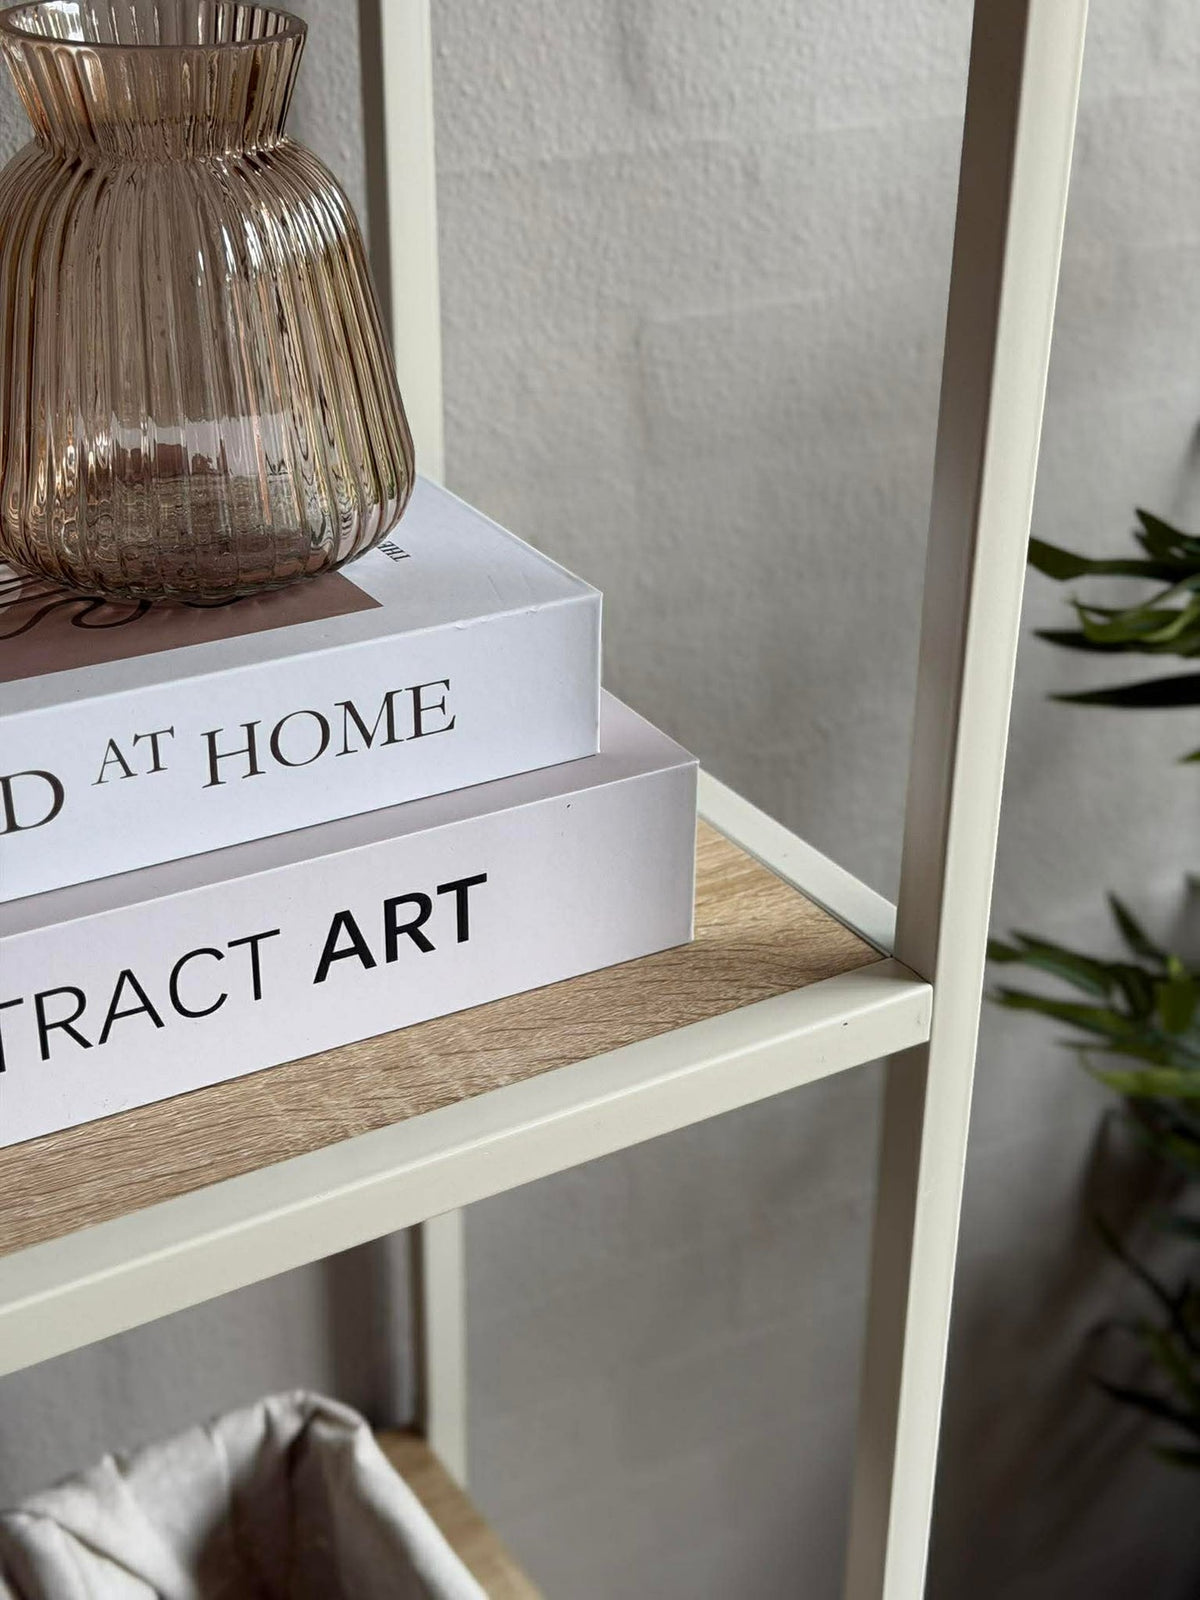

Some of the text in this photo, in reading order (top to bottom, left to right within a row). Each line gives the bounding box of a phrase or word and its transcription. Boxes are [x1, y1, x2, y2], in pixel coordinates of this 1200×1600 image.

[91, 725, 175, 786] AT
[200, 678, 457, 788] HOME
[312, 872, 488, 985] ART
